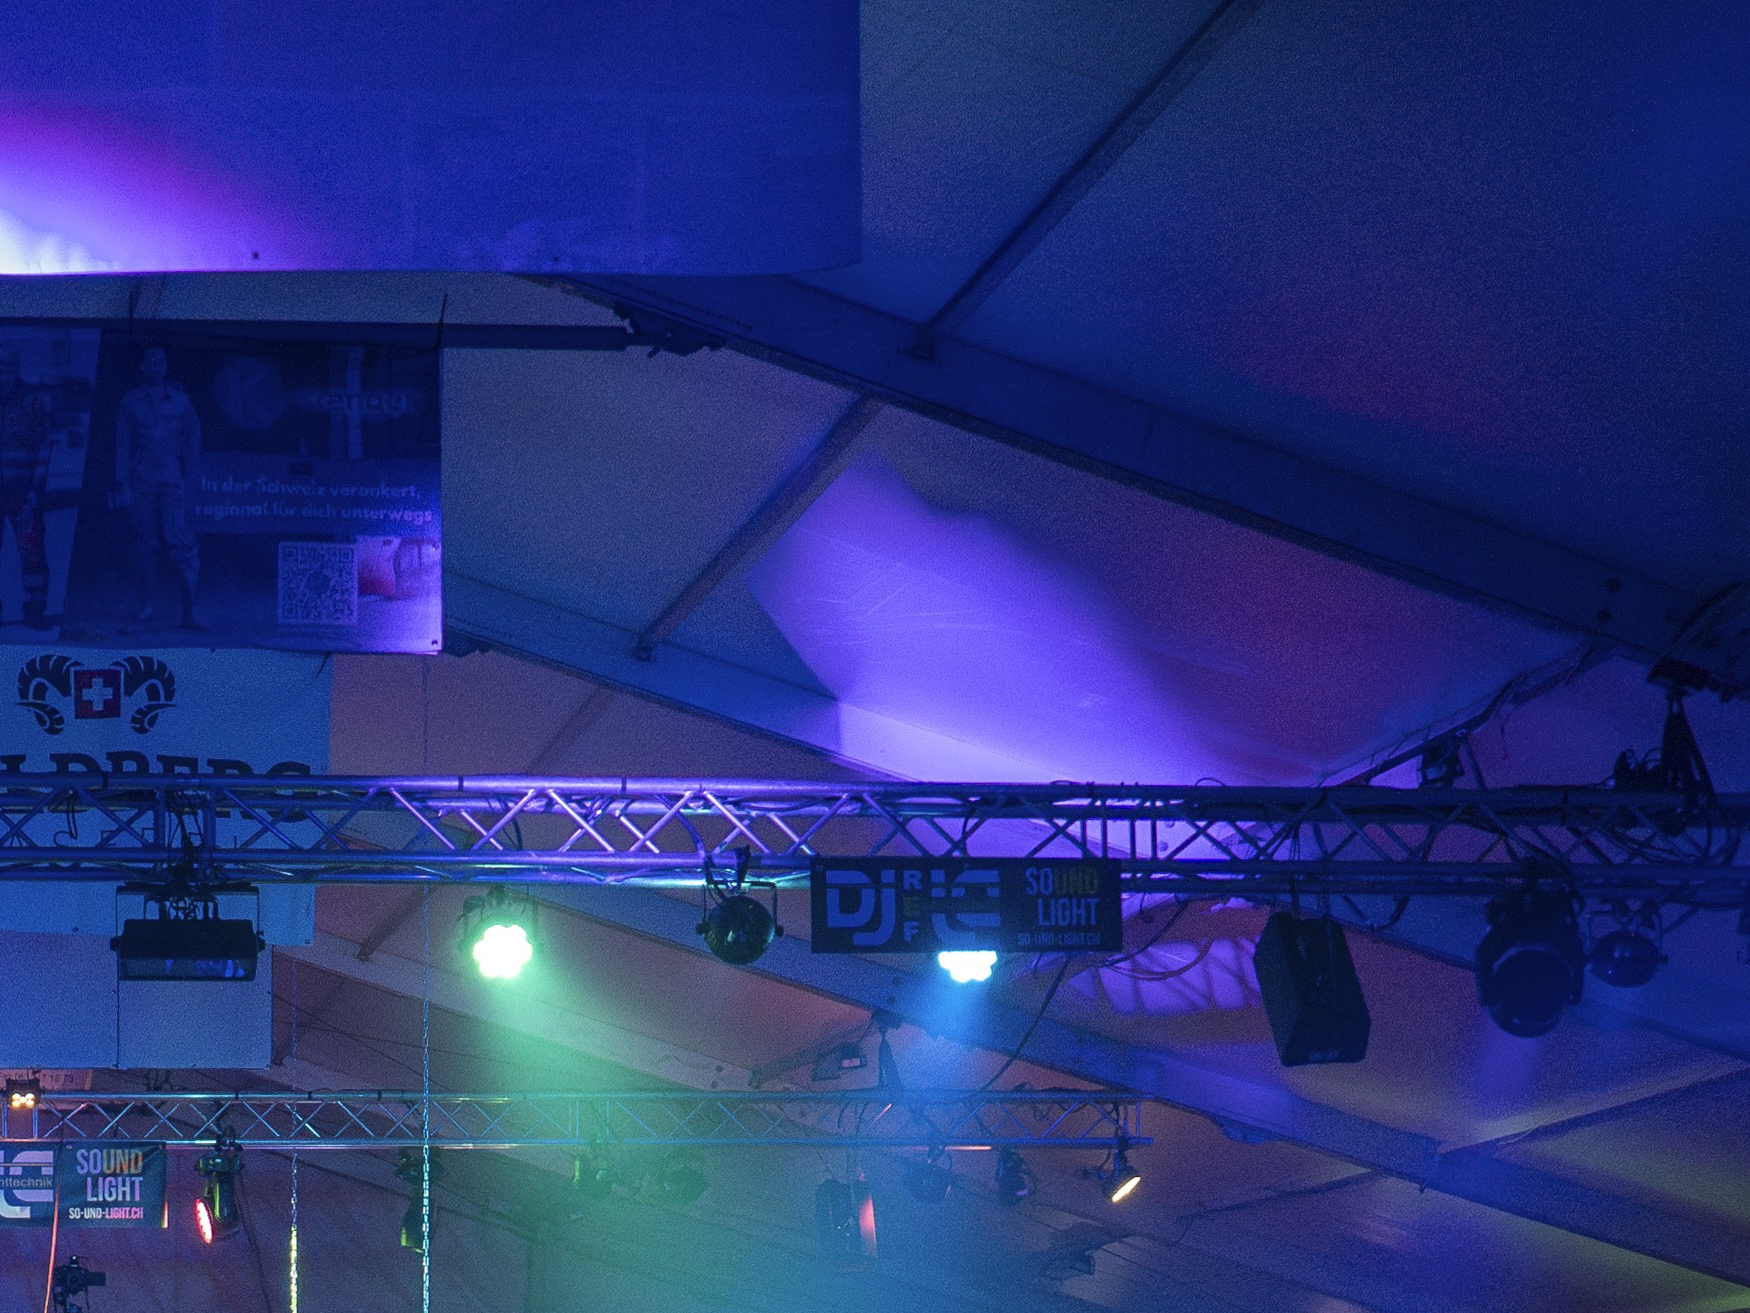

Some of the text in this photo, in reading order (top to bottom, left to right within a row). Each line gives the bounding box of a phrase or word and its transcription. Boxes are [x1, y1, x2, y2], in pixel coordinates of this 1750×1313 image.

[1037, 898, 1100, 926] LIGHT
[76, 1149, 144, 1175] SOUND
[86, 1176, 144, 1202] LIGHT
[68, 1207, 144, 1220] SO-UND-LIGHT.CH
